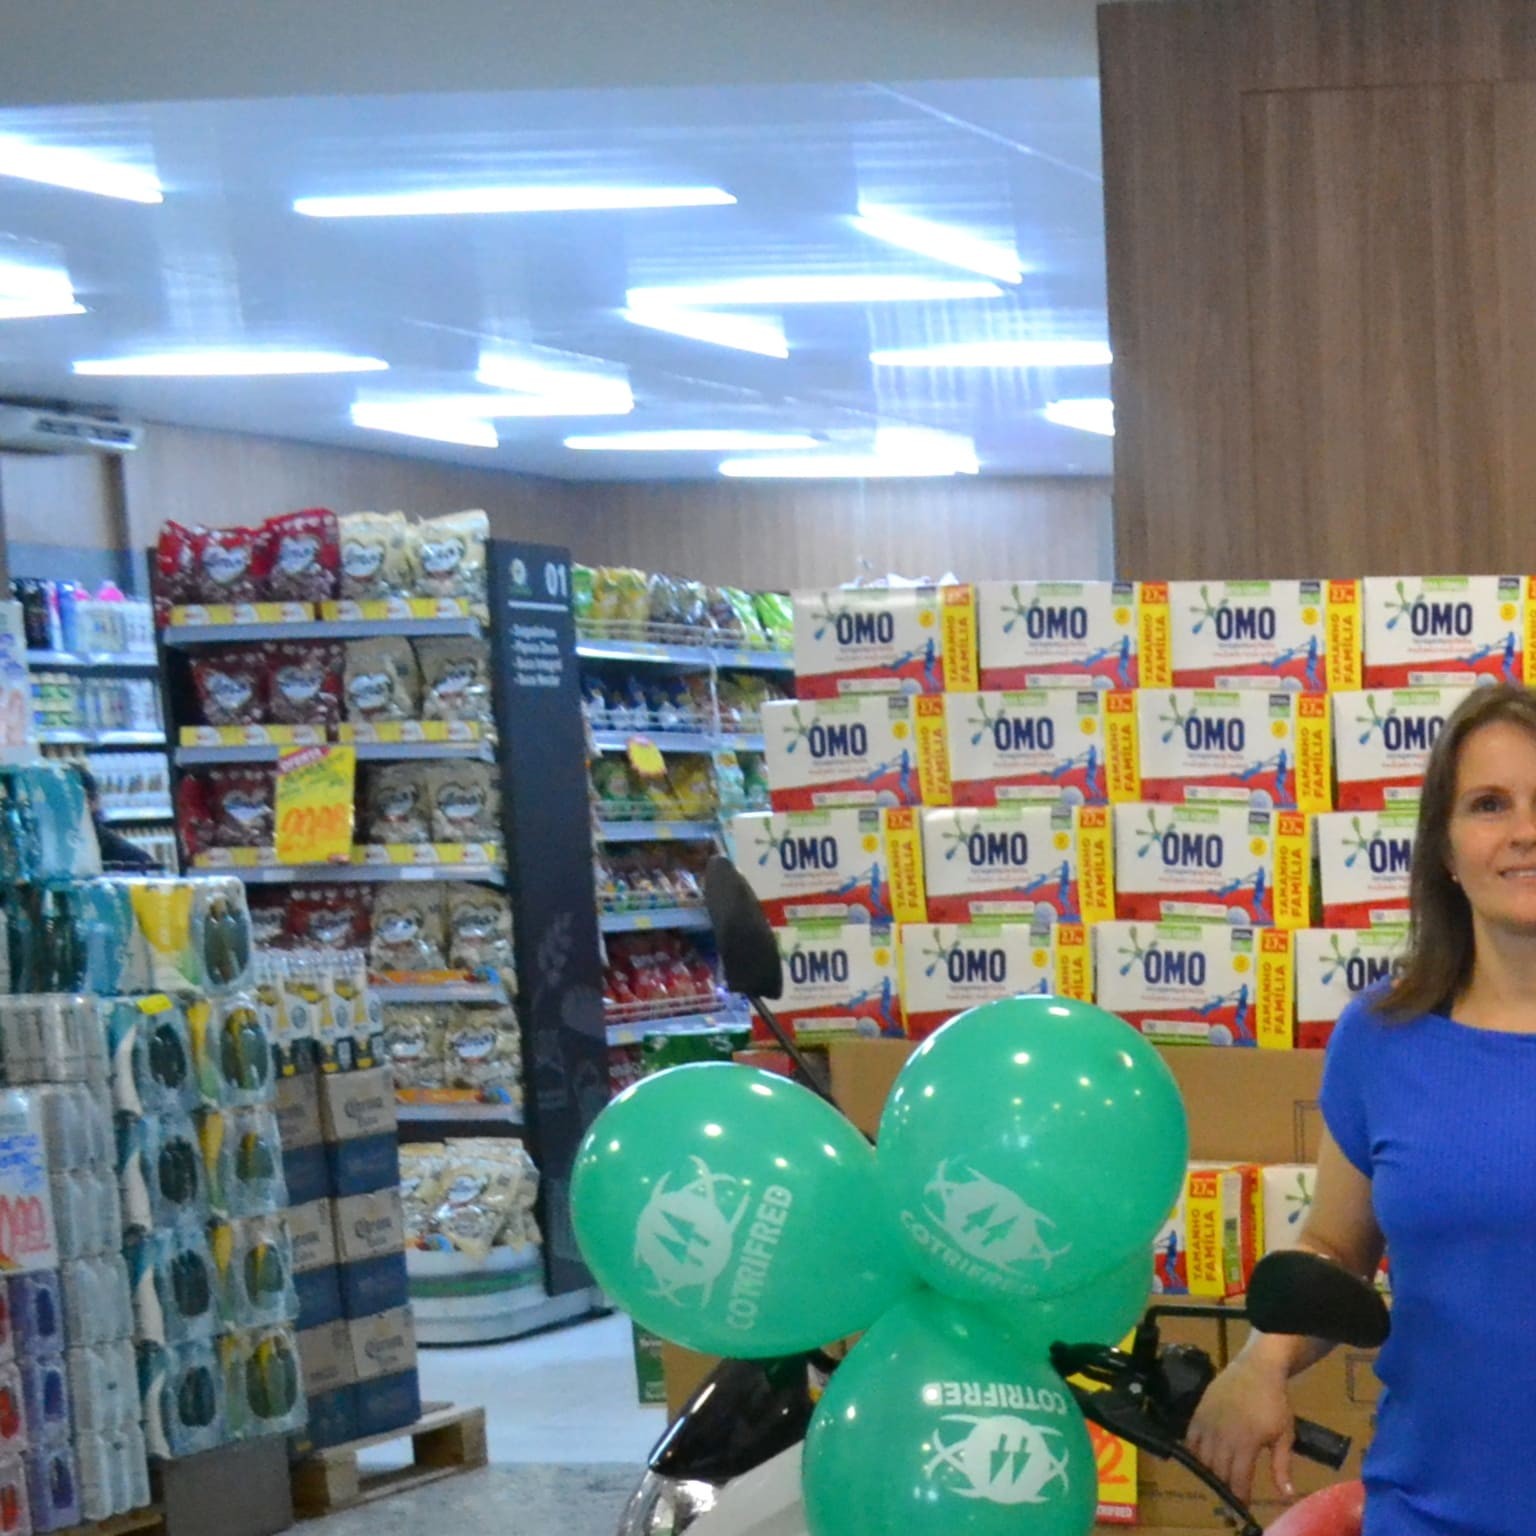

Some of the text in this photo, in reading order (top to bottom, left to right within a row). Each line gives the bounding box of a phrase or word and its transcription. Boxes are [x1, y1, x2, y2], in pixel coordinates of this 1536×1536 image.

[545, 562, 567, 597] 01
[836, 611, 894, 645] OMO
[1027, 606, 1088, 639] OMO
[1216, 606, 1276, 641] OMO
[1411, 602, 1473, 637] OMO
[809, 723, 867, 758] OMO
[995, 717, 1055, 751] OMO
[1185, 716, 1245, 752] OMO
[780, 836, 839, 871] OMO
[968, 831, 1029, 866] OMO
[1162, 833, 1223, 868] OMO
[1370, 838, 1411, 873] OM
[790, 949, 848, 983] OMO
[948, 949, 1007, 982] OMO
[1144, 951, 1206, 985] OMO
[726, 1184, 794, 1331] COTRIFRED
[1206, 1210, 1216, 1283] FAMÍLIA
[922, 1381, 1067, 1416] COTRIFRED
